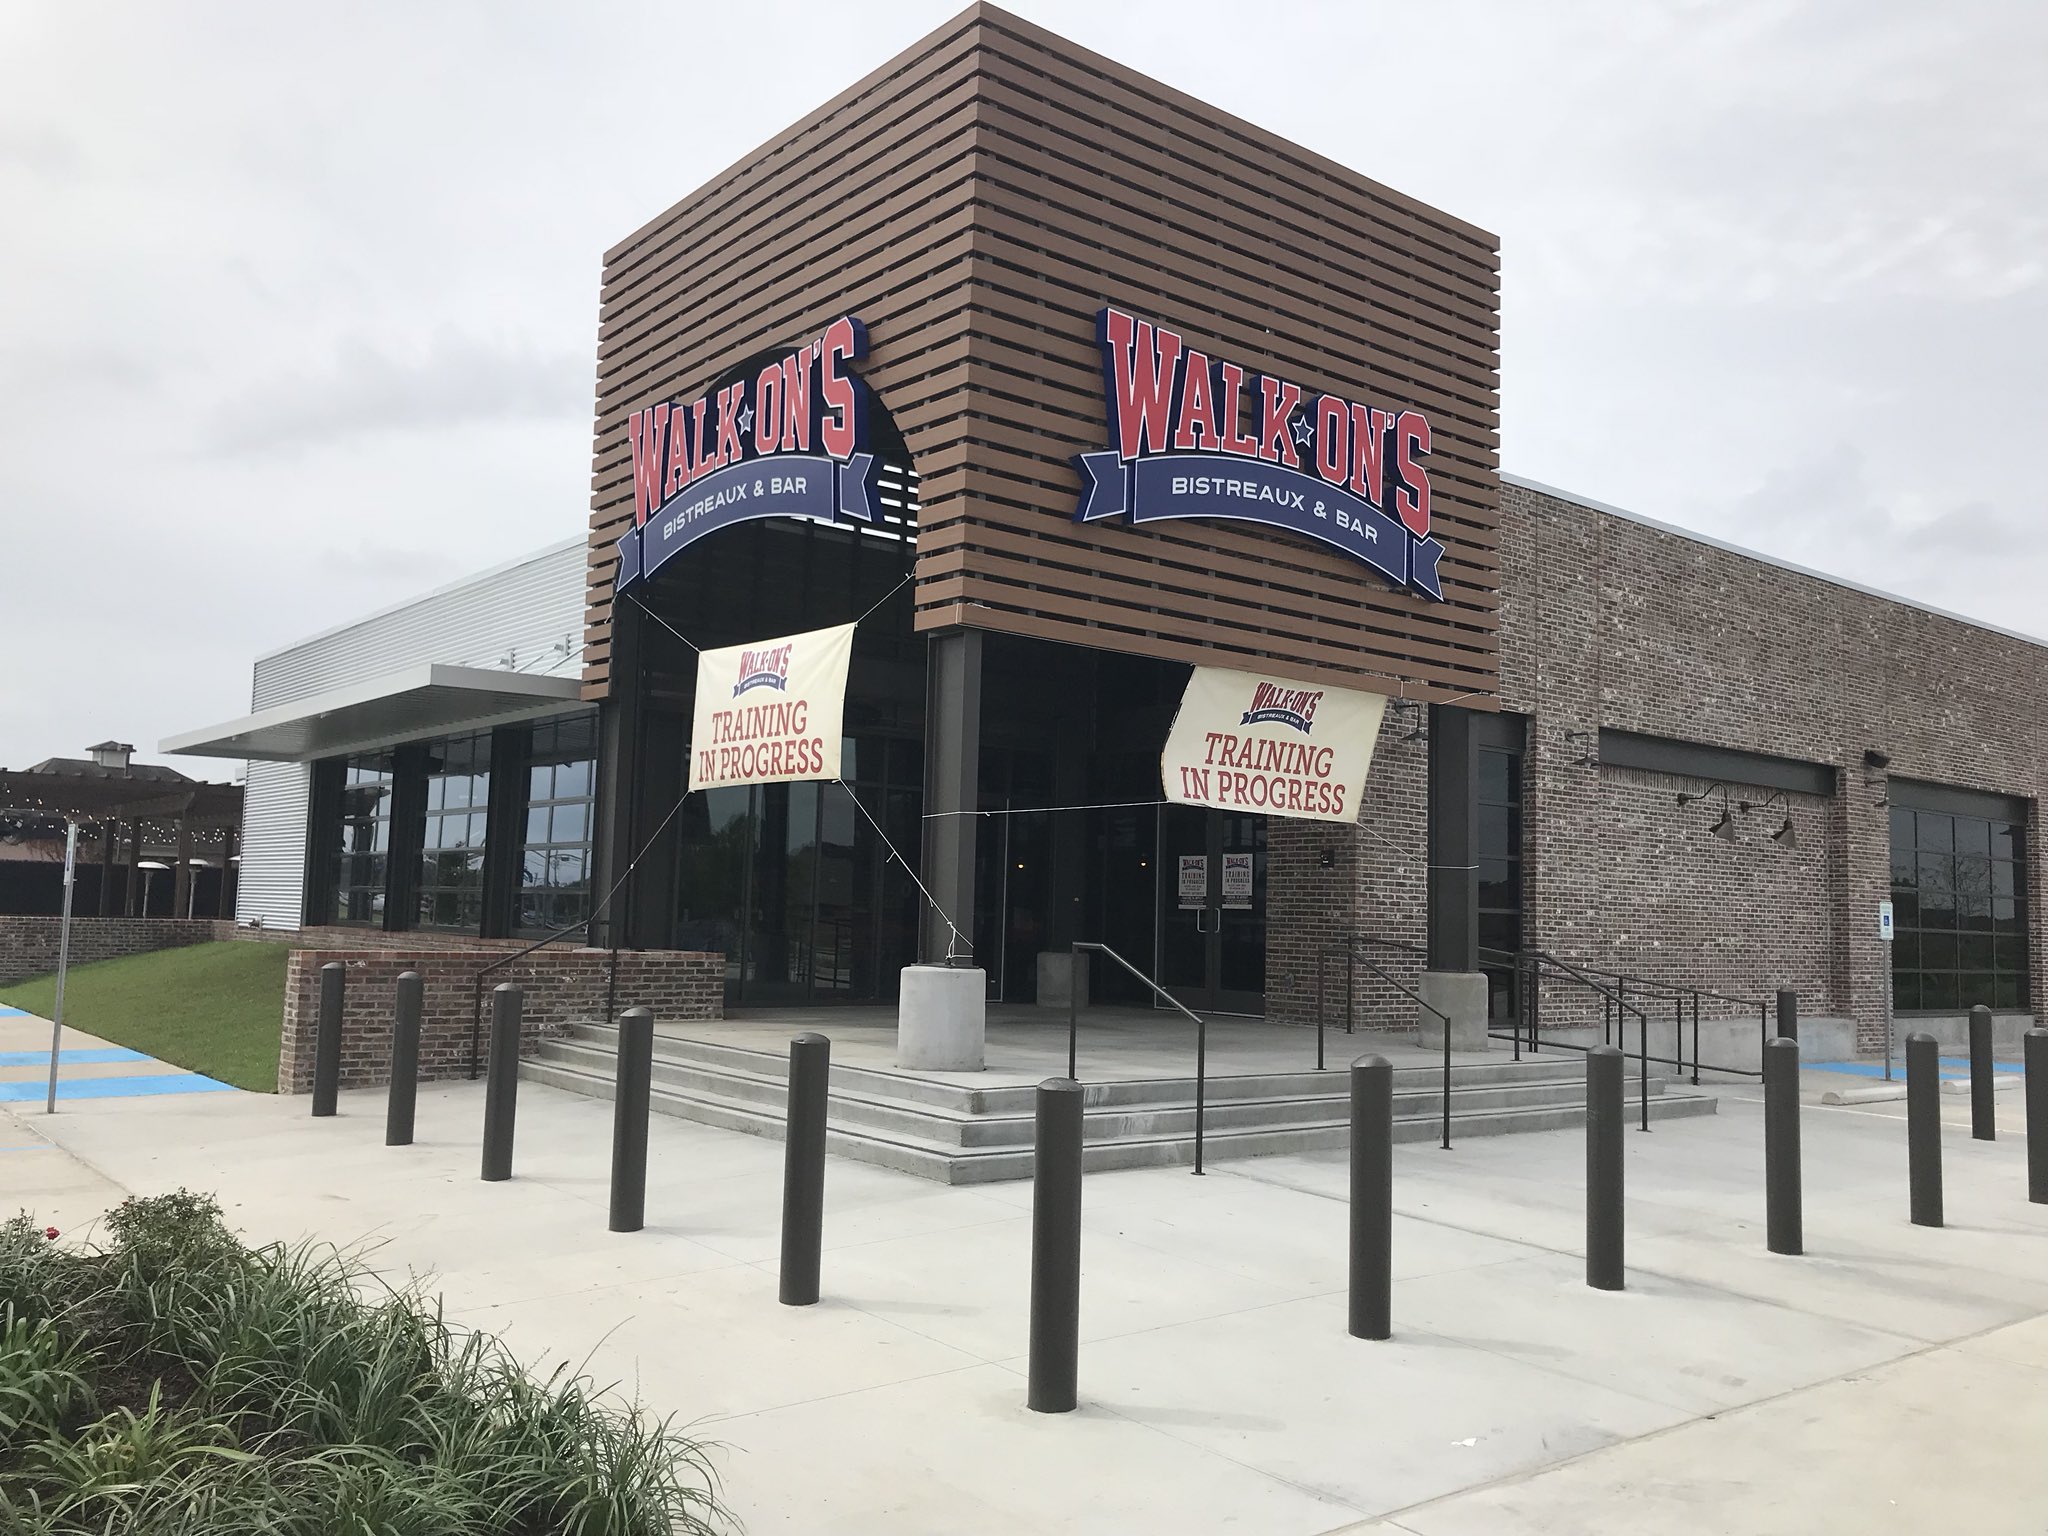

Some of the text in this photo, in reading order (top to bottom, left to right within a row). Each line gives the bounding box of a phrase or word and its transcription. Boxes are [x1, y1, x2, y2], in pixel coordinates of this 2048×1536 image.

[663, 476, 807, 541] BISTREAUX & BAR
[1172, 477, 1378, 545] BISTREAUX & BAR
[712, 700, 808, 744] TRAINING
[1290, 716, 1300, 725] BAR
[699, 737, 823, 782] IN PROGRESS
[1204, 732, 1334, 778] TRAINING
[1180, 766, 1346, 815] IN PROGRESS
